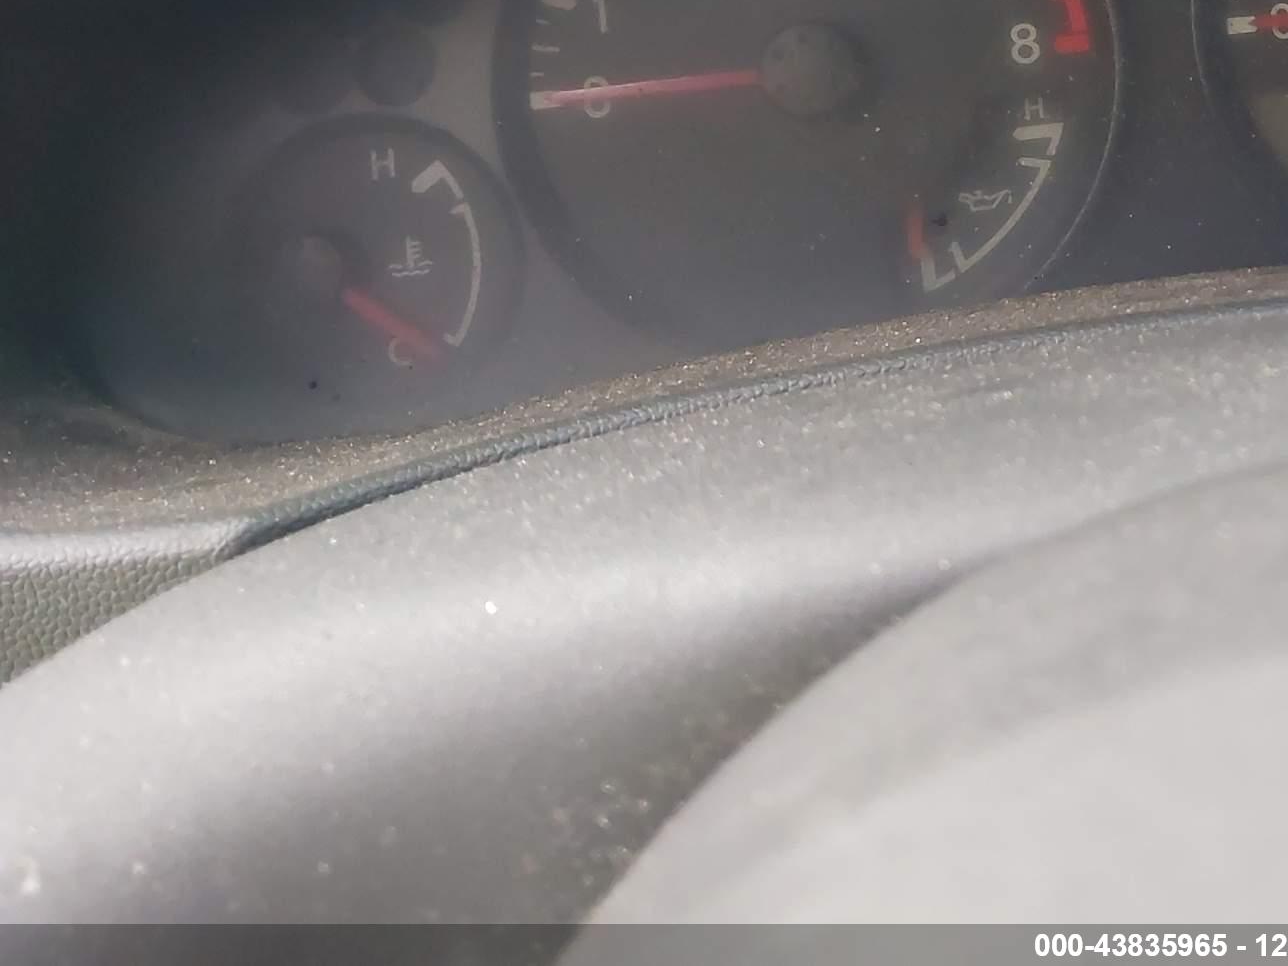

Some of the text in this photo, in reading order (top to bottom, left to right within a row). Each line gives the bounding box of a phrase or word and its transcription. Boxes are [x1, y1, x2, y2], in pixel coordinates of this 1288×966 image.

[1010, 24, 1040, 64] 8
[583, 76, 611, 118] 0
[1024, 97, 1044, 120] H
[370, 148, 396, 181] H
